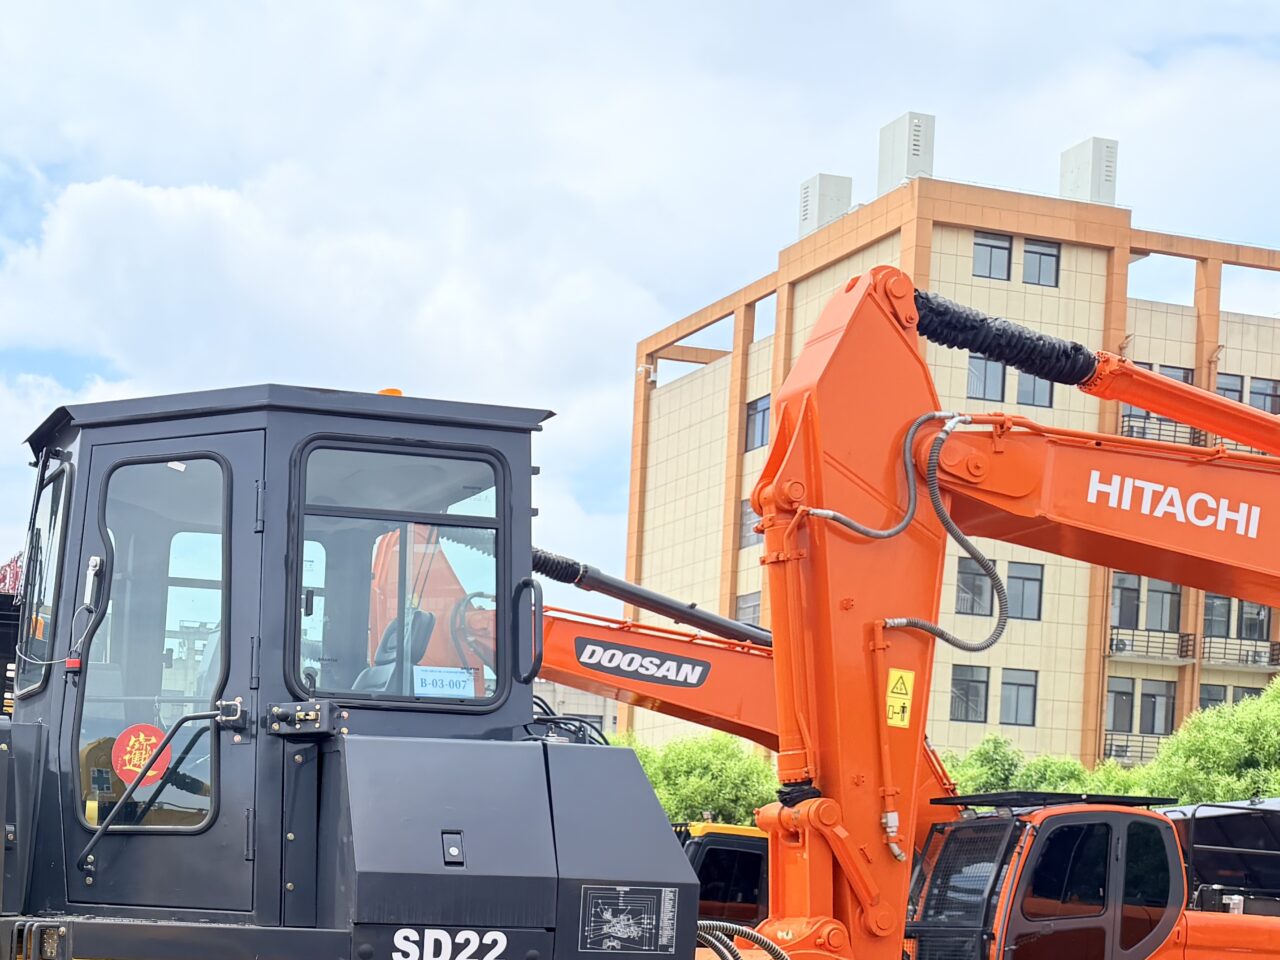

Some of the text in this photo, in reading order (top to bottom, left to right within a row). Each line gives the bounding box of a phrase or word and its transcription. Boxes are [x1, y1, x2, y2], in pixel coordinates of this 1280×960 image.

[1087, 469, 1261, 539] HITACHI
[420, 677, 467, 690] B-03-007
[579, 644, 703, 684] DOOSAN
